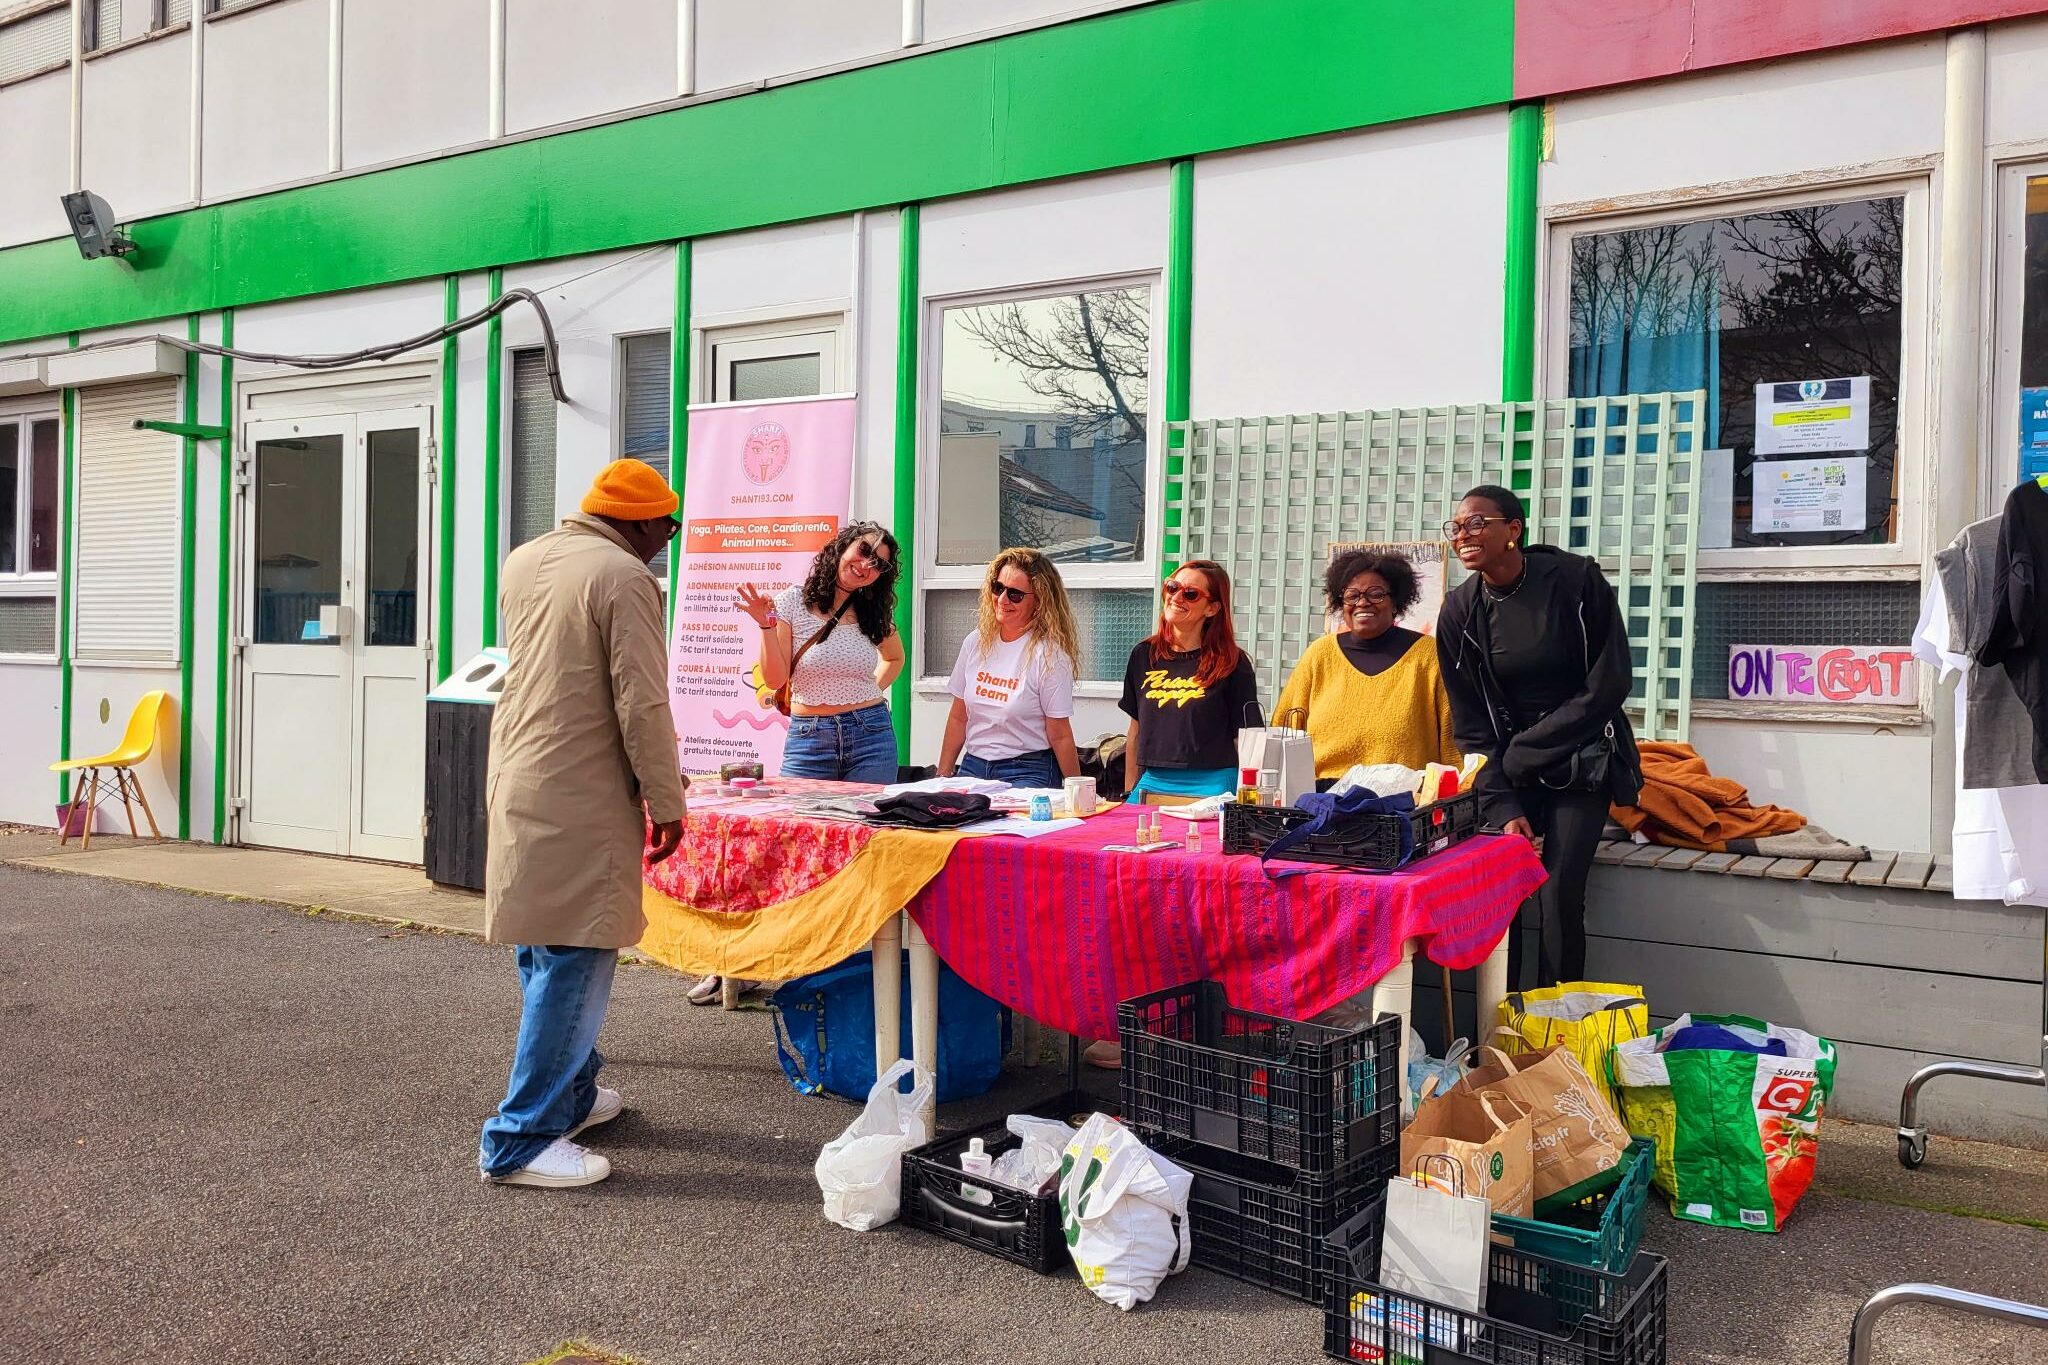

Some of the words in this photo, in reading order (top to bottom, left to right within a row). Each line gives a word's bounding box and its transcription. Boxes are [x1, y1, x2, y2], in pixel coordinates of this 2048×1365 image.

[731, 494, 794, 504] SHANTI93.COM
[689, 524, 713, 537] Yoga,
[714, 523, 747, 535] Pilates,
[747, 523, 771, 535] Core,
[772, 522, 804, 533] Cardio
[804, 522, 833, 533] renfo,
[721, 538, 759, 548] Animal
[759, 539, 794, 547] moves...
[688, 562, 727, 571] ADHÉSION
[728, 562, 766, 571] ANNUELLE
[686, 582, 740, 590] ABONNEMENT
[685, 594, 706, 602] Accès
[713, 594, 729, 602] tous
[730, 594, 741, 602] les
[693, 604, 719, 612] illimité
[682, 623, 701, 631] PASS
[702, 623, 711, 631] 10
[711, 623, 738, 632] COURS
[695, 635, 711, 643] tarif
[712, 635, 744, 644] solidaire
[679, 645, 693, 653] 75€
[694, 645, 710, 654] tarif
[711, 646, 744, 655] standard
[677, 664, 704, 673] COURS
[705, 663, 710, 673] À
[712, 664, 741, 675] L'UNITÉ
[1731, 647, 1774, 697] ON
[1775, 652, 1815, 696] TE
[676, 675, 686, 683] 5€
[687, 676, 703, 684] tarif
[703, 676, 735, 686] solidaire
[976, 671, 1020, 691] Shanti
[675, 686, 688, 694] 10€
[688, 687, 704, 695] tarif
[705, 688, 738, 698] standard
[975, 684, 1009, 703] team
[684, 736, 712, 745] Ateliers
[713, 737, 753, 748] découverte
[683, 747, 712, 757] gratuits
[713, 748, 732, 757] toute
[732, 749, 759, 759] l'année
[682, 766, 718, 776] Dimanche
